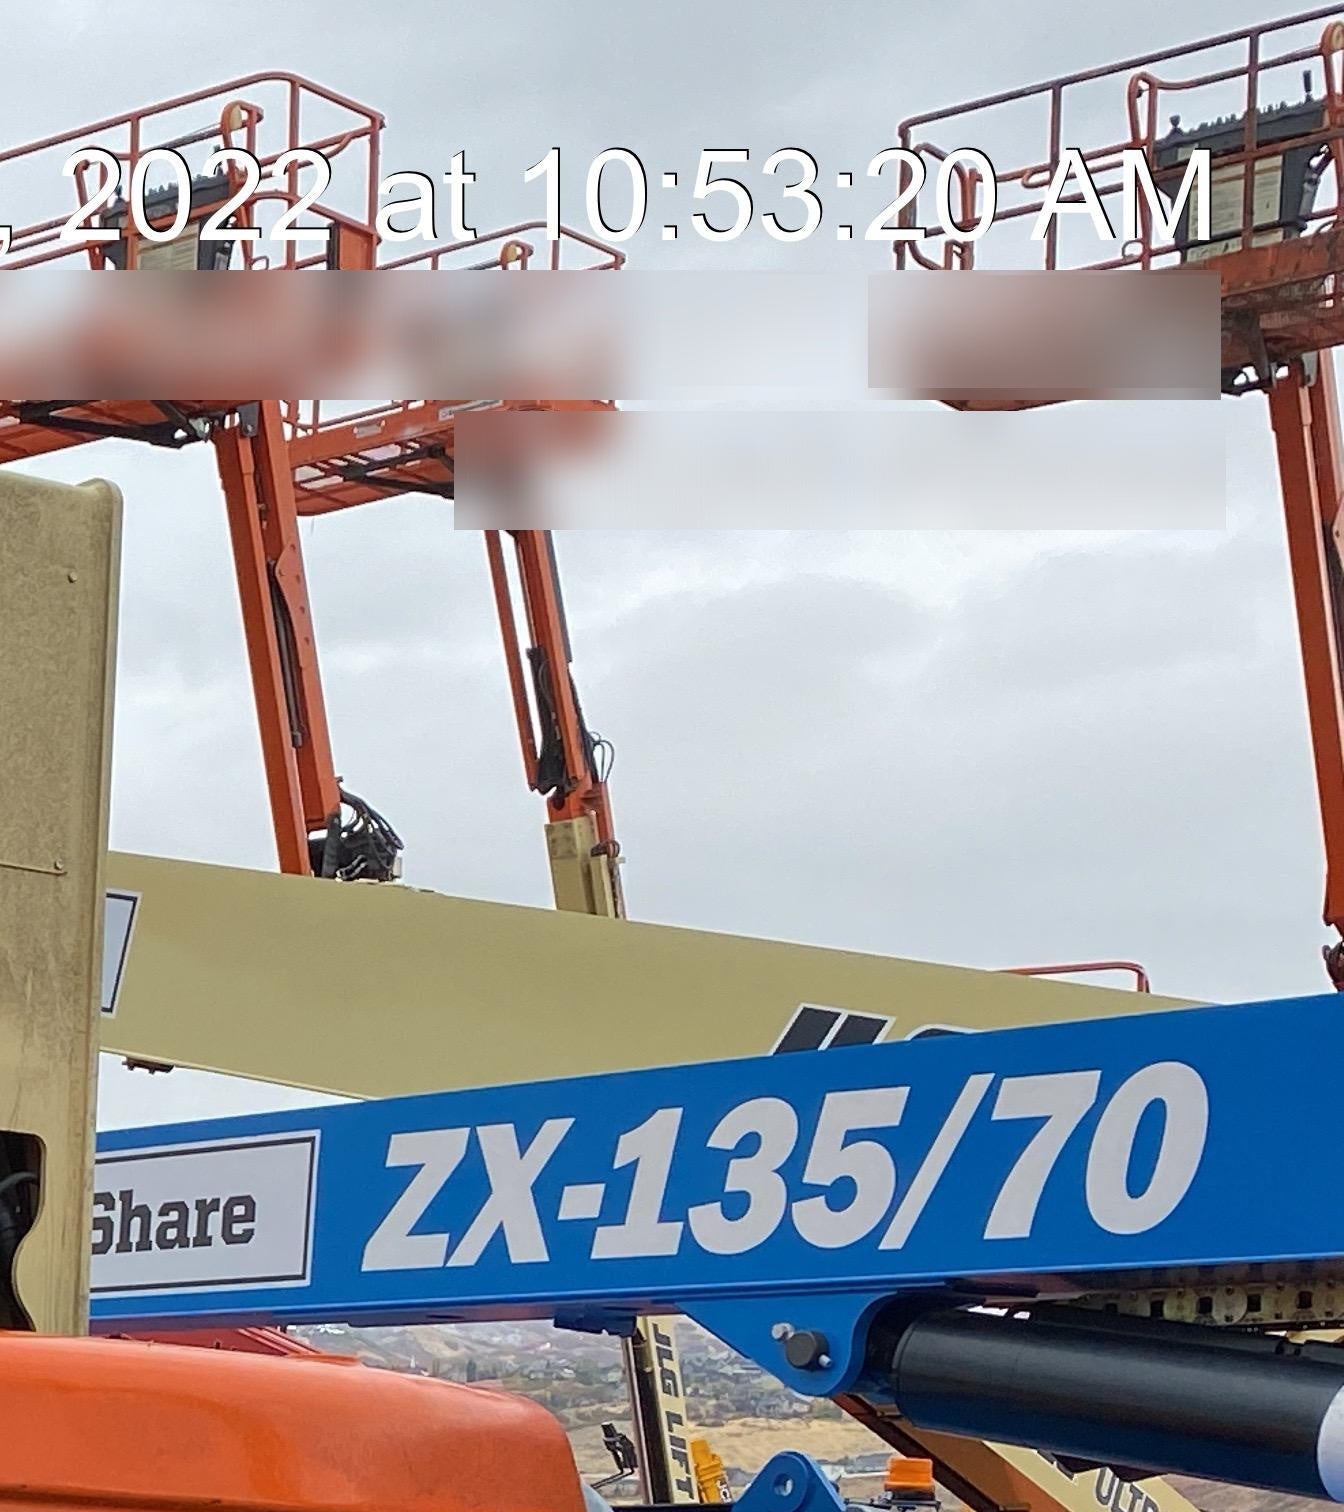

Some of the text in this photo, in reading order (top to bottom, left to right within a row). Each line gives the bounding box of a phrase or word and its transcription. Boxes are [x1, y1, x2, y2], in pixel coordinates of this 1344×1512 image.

[361, 1061, 1210, 1272] ZX-135/70
[651, 1322, 696, 1500] JLG LIFT
